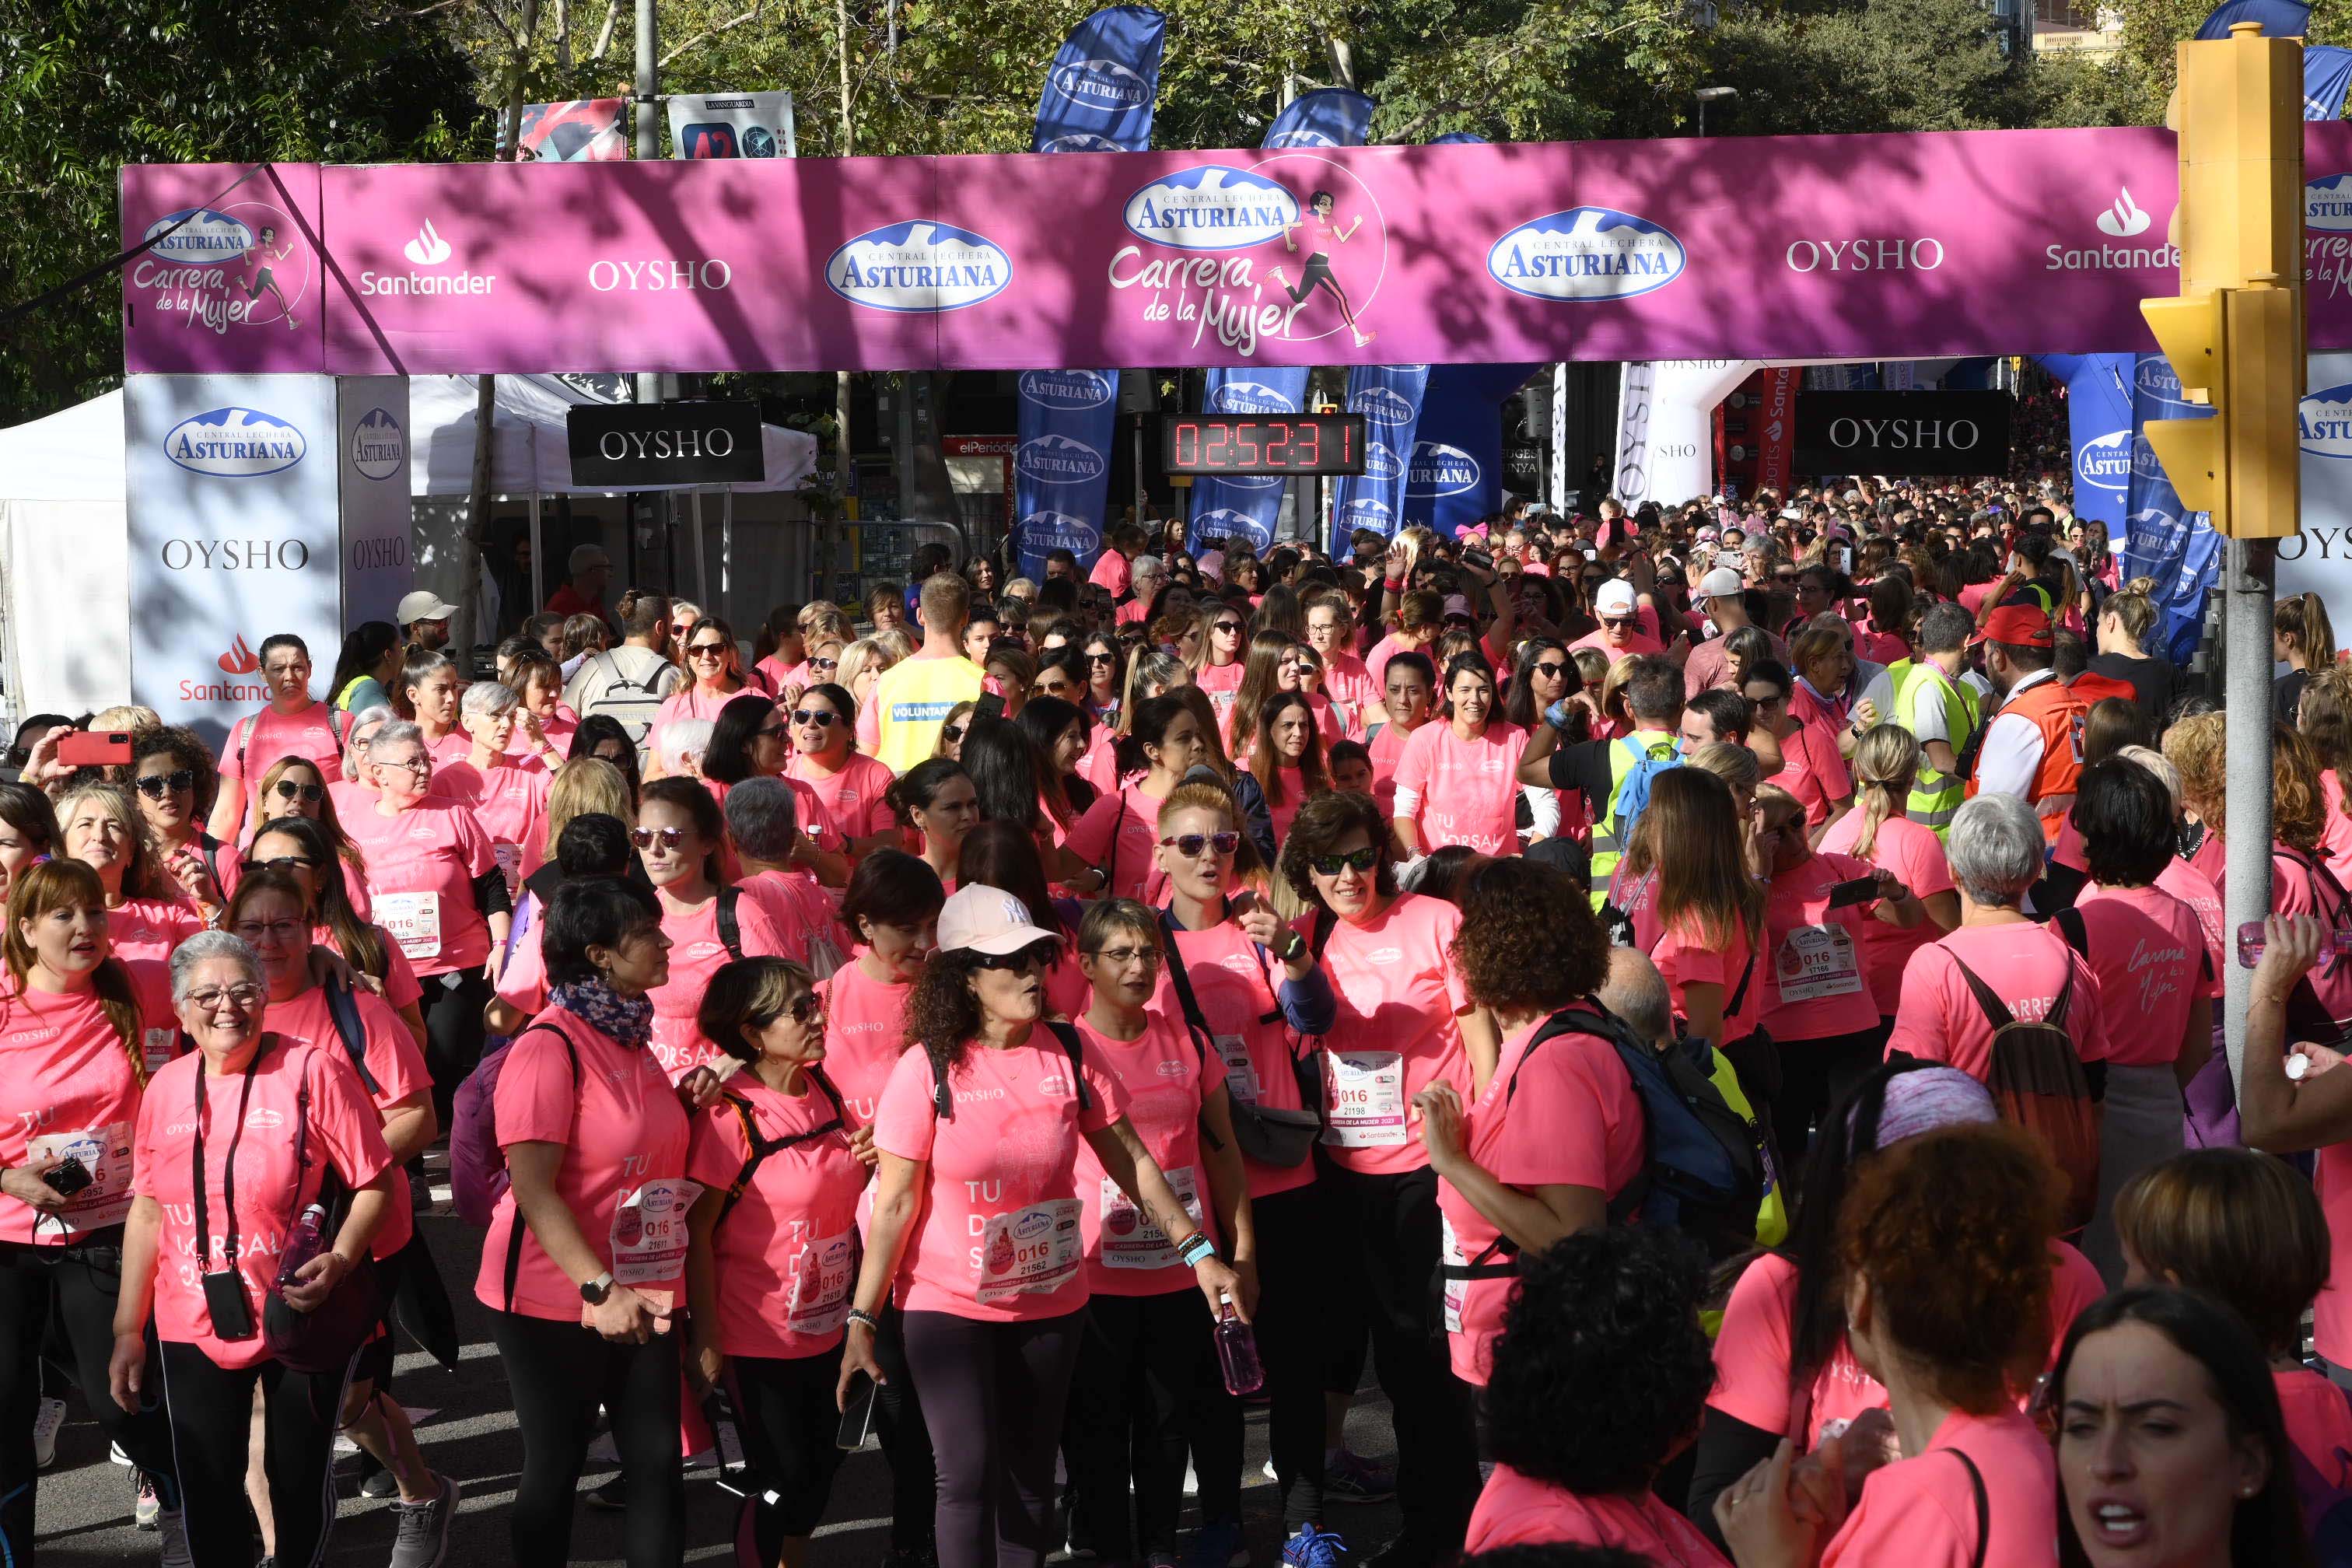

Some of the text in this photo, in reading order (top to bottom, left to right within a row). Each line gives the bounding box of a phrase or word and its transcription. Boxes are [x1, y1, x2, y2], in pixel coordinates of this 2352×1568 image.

[1062, 72, 1142, 102] ASTURIANA
[1136, 198, 1286, 229] ASTURIANA
[2305, 202, 2352, 218] STUR
[149, 229, 245, 250] ASTURIANA
[1533, 238, 1664, 250] CENTRAL LECHERA
[868, 252, 927, 261] CENTRAL
[1503, 243, 1671, 278] ASTURIANA
[1787, 238, 1944, 272] OYSHO
[133, 261, 225, 290] Carrera
[588, 259, 731, 291] OYSHO
[840, 257, 998, 289] ASTURIANA
[1108, 246, 1254, 289] Carrera
[361, 271, 496, 296] Santander
[156, 287, 259, 334] de la Mujer
[1143, 284, 1307, 356] de la Mujer
[1025, 375, 1103, 401] ASTURIANA
[1354, 397, 1408, 421] ASTURIANA
[175, 432, 296, 460] ASTURIANA
[600, 428, 733, 460] OYSHO
[1829, 418, 1979, 450] OYSHO
[355, 435, 401, 462] ASTURIANA
[1023, 450, 1097, 474] ASTURIANA
[1021, 527, 1090, 549] ASTURIANA
[162, 539, 310, 570] OYSHO
[353, 536, 404, 571] OYSHO
[892, 706, 951, 718] VOLUNTARI
[389, 919, 414, 929] 016
[1804, 951, 1829, 965] 016
[12, 1026, 61, 1044] OYSHO
[842, 1022, 884, 1034] OYSHO
[956, 1088, 1004, 1103] OYSHO
[1341, 1090, 1367, 1103] 016
[17, 1107, 54, 1131] TU
[1344, 1107, 1366, 1115] 21198
[624, 1155, 651, 1178] TU
[964, 1178, 1002, 1203] TU
[163, 1202, 194, 1226] TU
[645, 1219, 670, 1236] 016
[789, 1217, 819, 1243] TU
[1017, 1219, 1049, 1237] ASTURIANA
[1017, 1241, 1049, 1262] 016
[1112, 1254, 1146, 1264] OYSHO
[1020, 1261, 1047, 1275] 21562
[822, 1271, 845, 1290] 016
